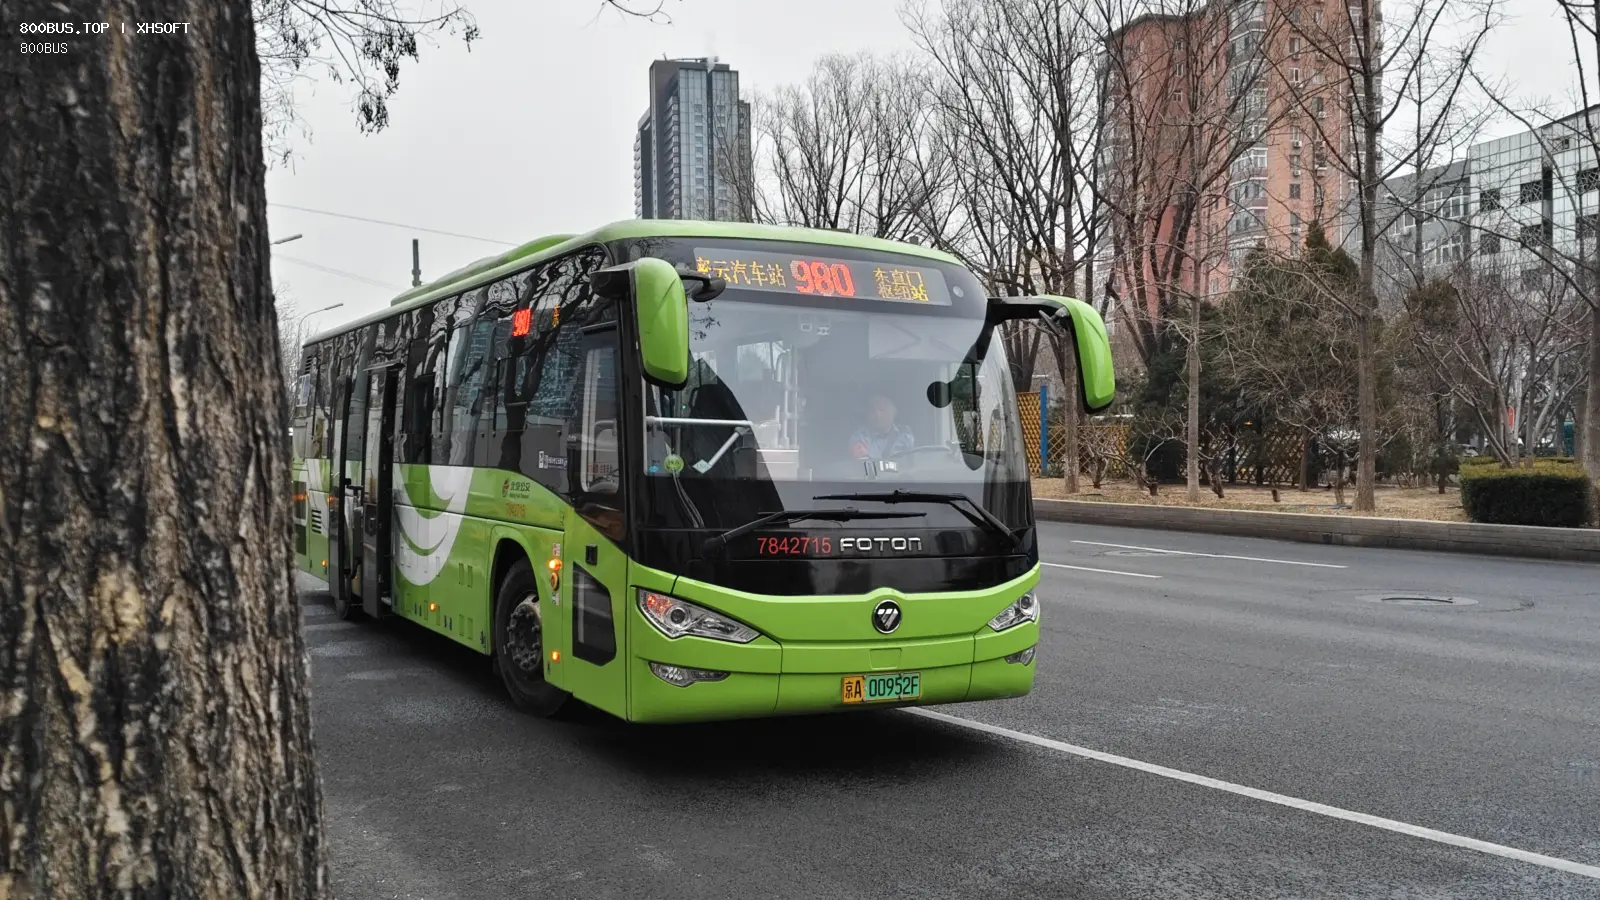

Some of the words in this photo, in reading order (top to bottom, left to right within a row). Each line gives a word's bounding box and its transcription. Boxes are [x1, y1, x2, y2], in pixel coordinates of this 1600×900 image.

[789, 259, 855, 297] 980
[873, 267, 923, 288] 东直门
[757, 537, 832, 554] 7842715
[840, 537, 922, 551] FOTON
